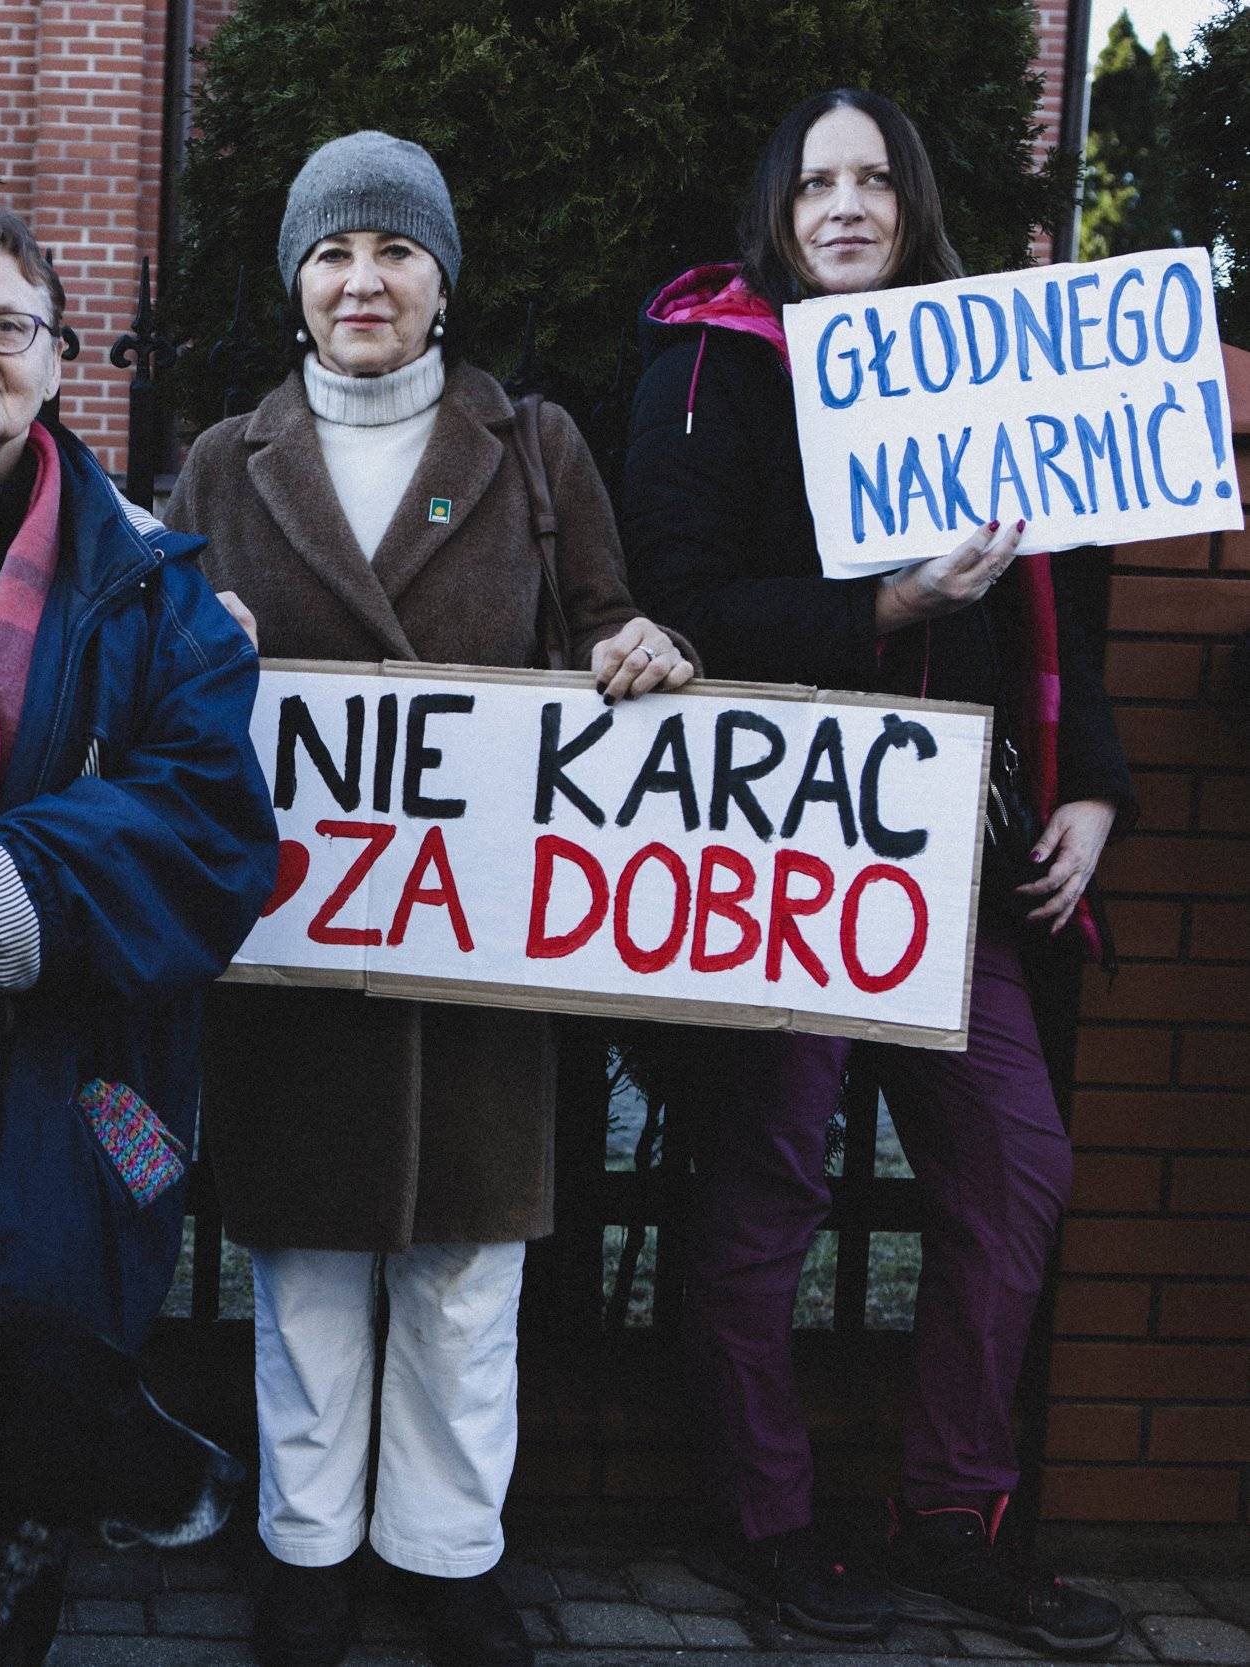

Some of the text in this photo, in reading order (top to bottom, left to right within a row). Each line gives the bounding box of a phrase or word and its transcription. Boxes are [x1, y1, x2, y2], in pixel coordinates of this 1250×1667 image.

[816, 261, 1202, 410] GŁODNEGO
[849, 379, 1232, 544] NAKARMIĆ!
[273, 694, 937, 859] NIE KARAĆ
[306, 822, 928, 993] ZA DOBRO
